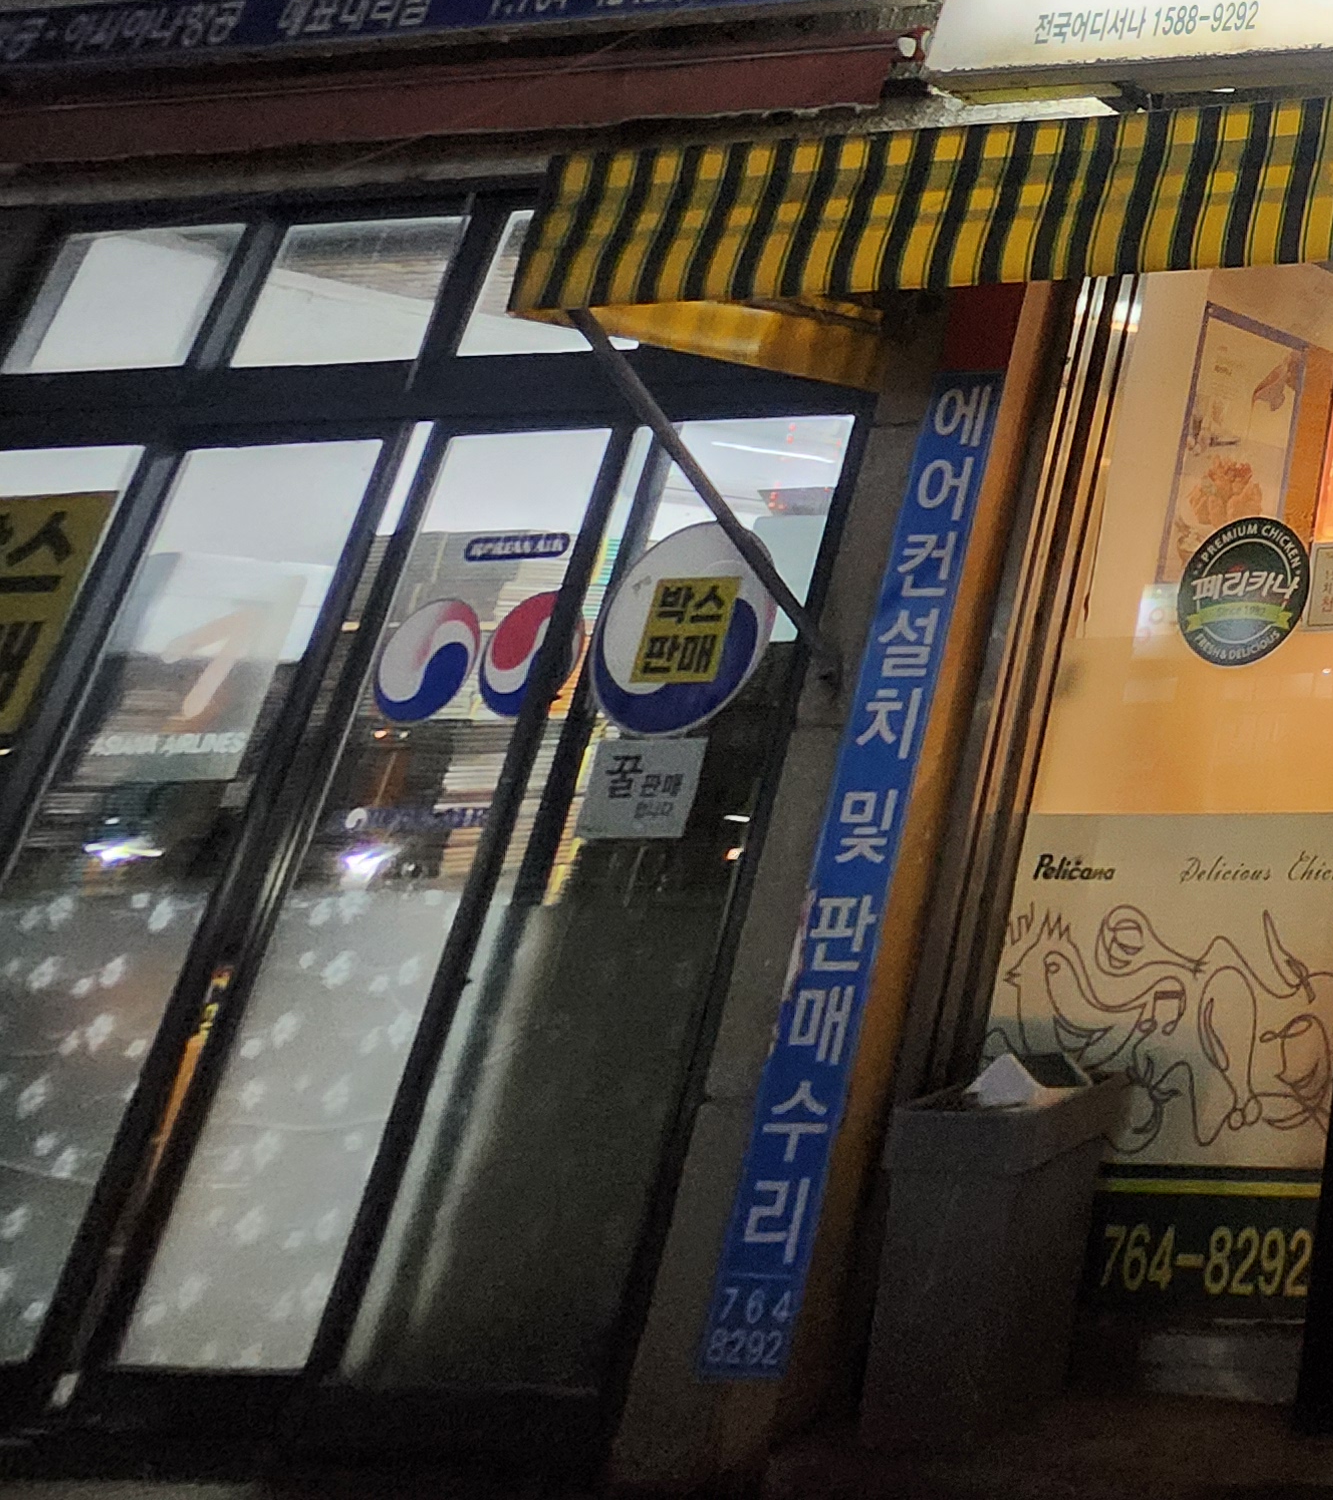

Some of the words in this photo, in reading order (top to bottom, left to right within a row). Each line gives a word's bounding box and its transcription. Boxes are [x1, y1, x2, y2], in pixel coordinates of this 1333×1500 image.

[1033, 3, 1147, 46] 전국어디서나
[1151, 0, 1260, 39] 1588-9292
[1200, 523, 1258, 563] PREMIUM
[1261, 524, 1302, 569] CHICKEN
[656, 584, 726, 625] 박스
[1190, 570, 1301, 601] 페리카나
[641, 633, 718, 674] 판매
[1228, 629, 1281, 660] DELICIOUS
[605, 753, 643, 799] 꿀
[639, 773, 684, 797] 판매
[834, 789, 896, 865] 및
[1032, 853, 1116, 882] Pelicana
[1180, 855, 1272, 883] Delicious
[1100, 1225, 1313, 1298] 764-8292
[717, 1286, 794, 1325] 764
[704, 1327, 783, 1368] 8292
